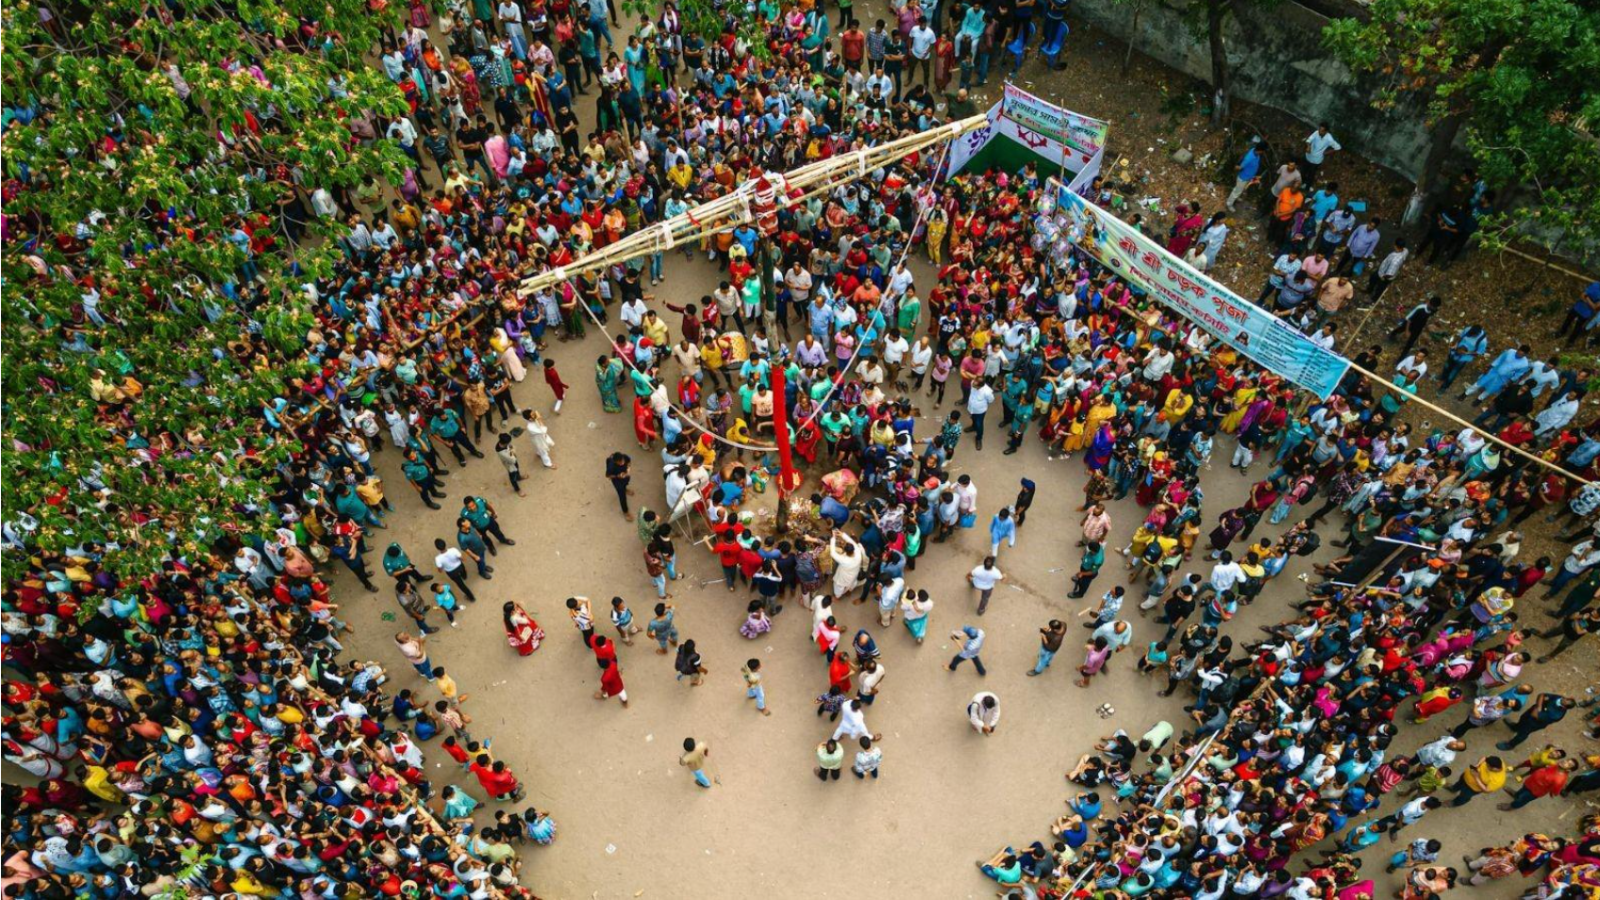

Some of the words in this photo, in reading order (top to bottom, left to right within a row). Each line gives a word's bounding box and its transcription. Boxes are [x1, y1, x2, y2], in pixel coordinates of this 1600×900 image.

[1118, 236, 1139, 259] শ্রী
[1142, 252, 1162, 275] শ্রী
[1166, 268, 1208, 299] চড়ক
[1210, 296, 1250, 325] পূজা
